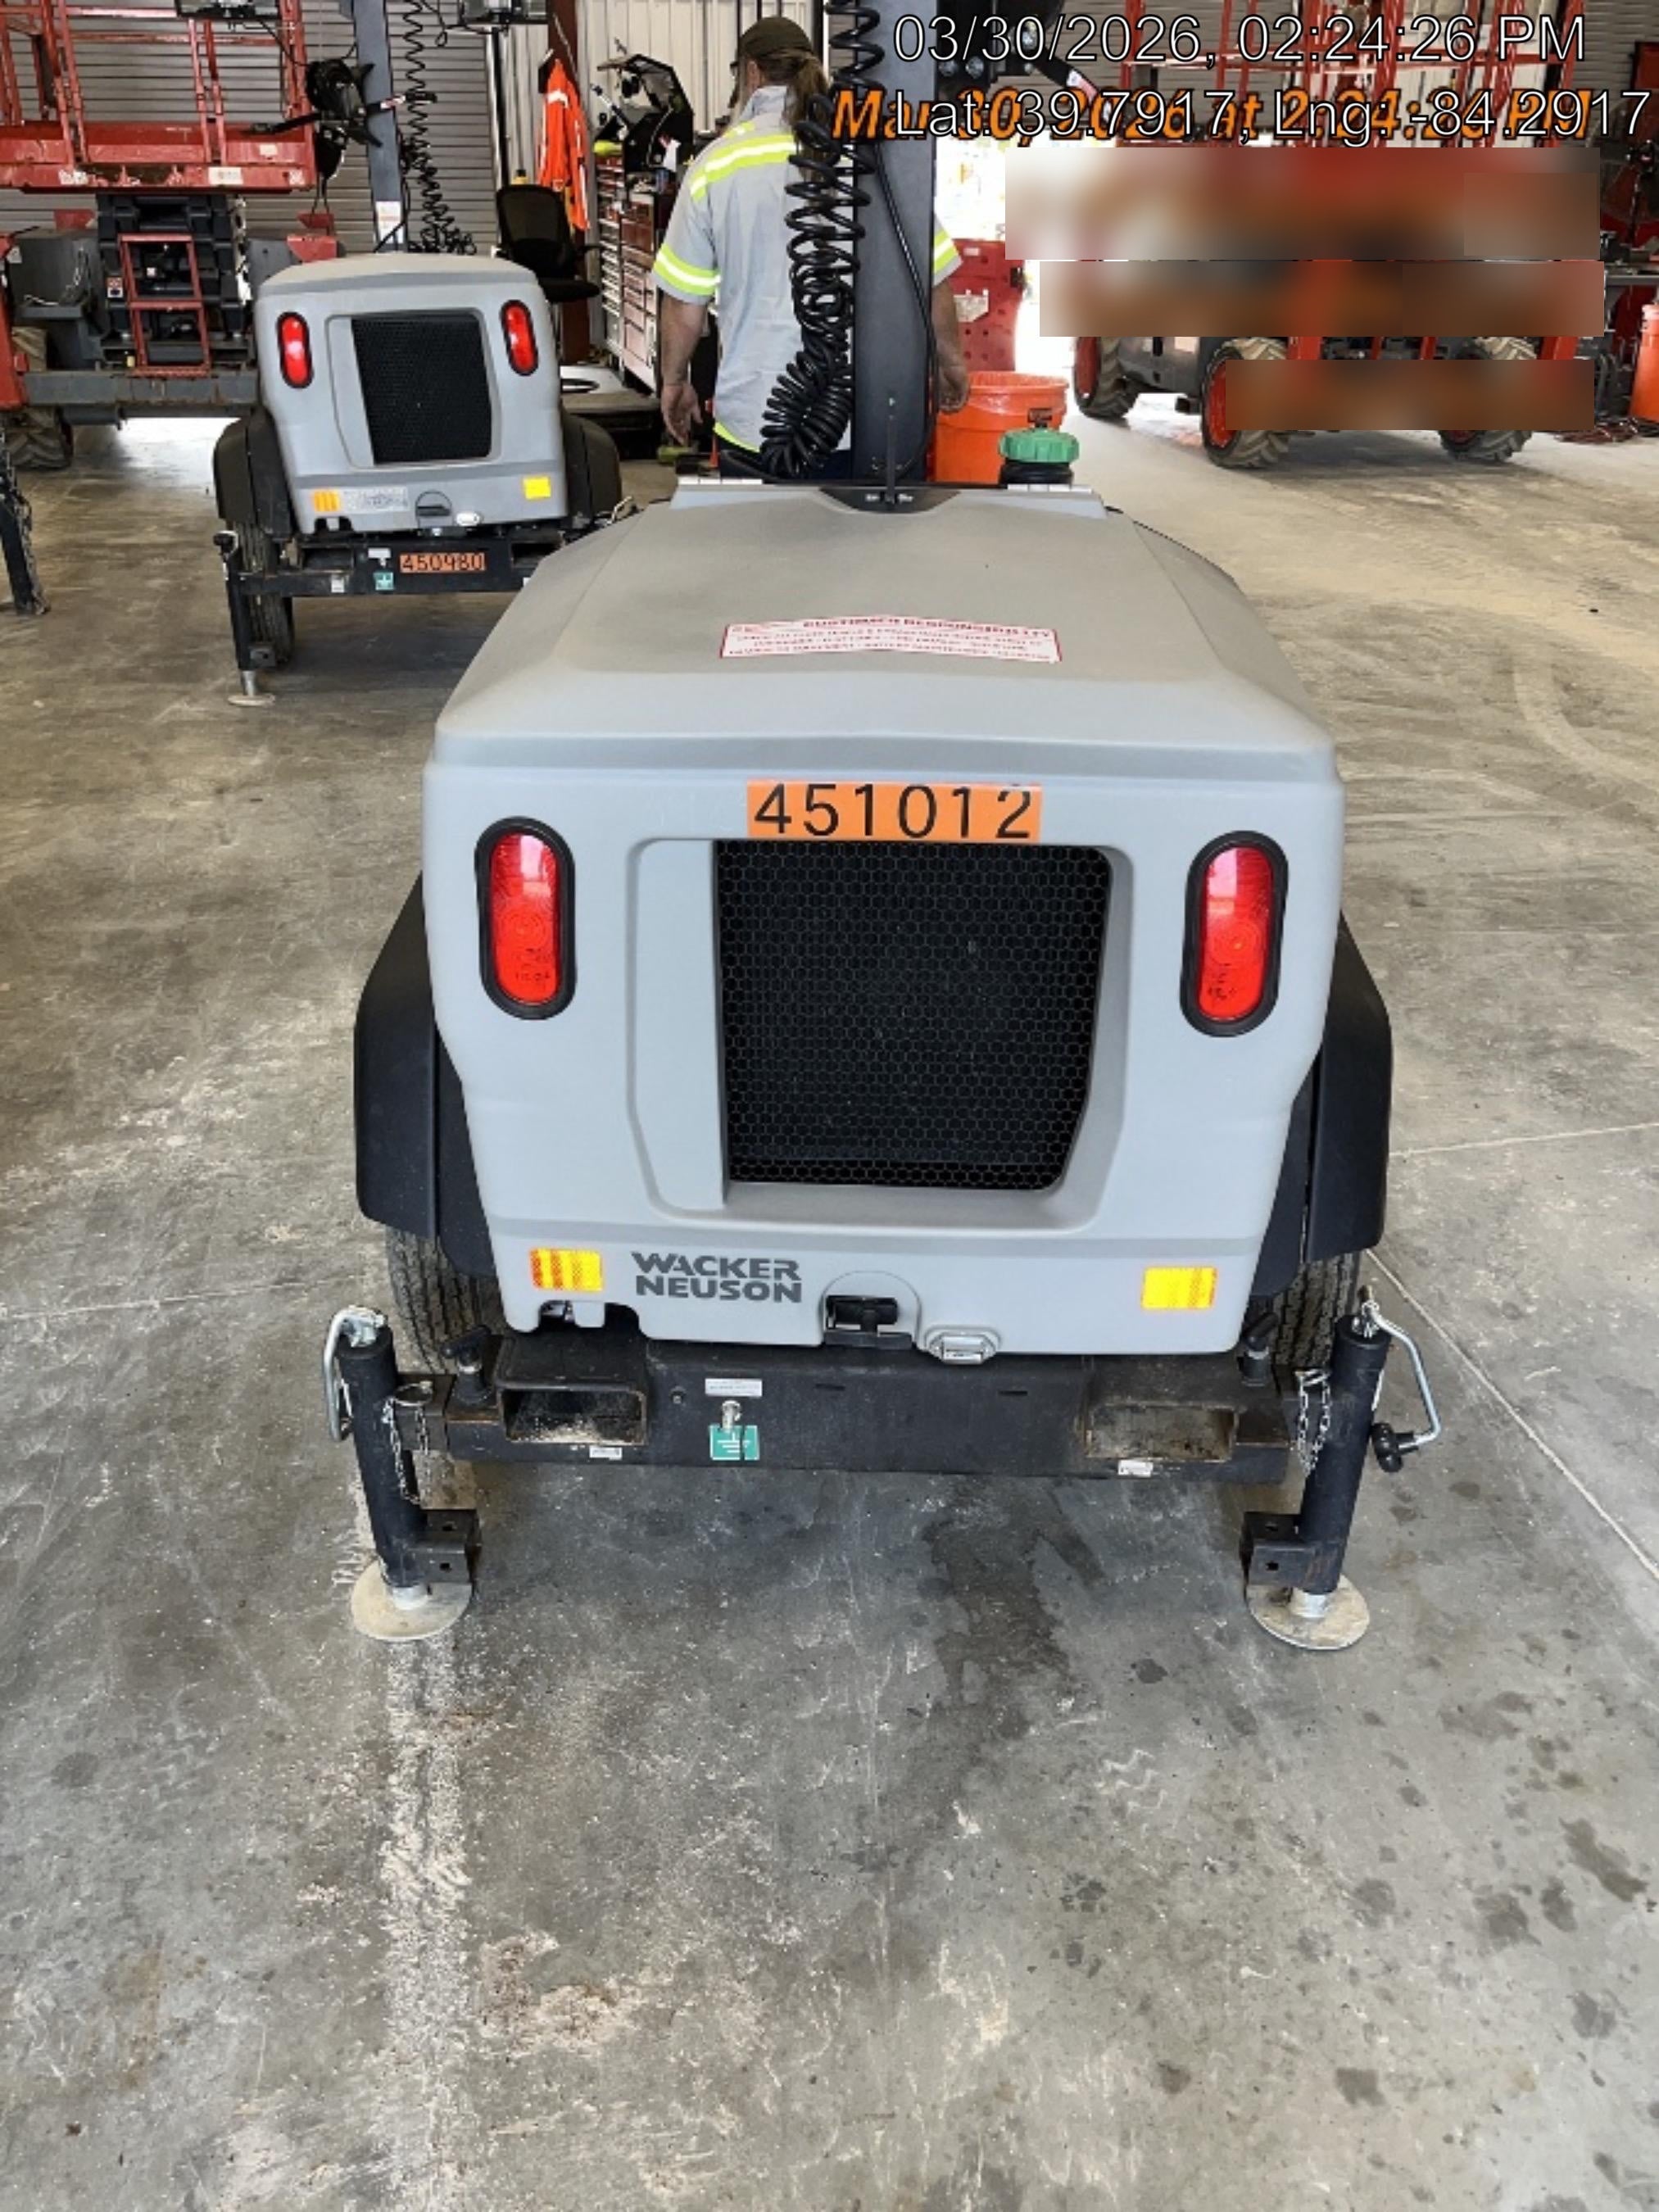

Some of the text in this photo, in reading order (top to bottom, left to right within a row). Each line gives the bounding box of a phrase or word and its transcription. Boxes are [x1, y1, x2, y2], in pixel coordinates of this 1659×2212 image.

[753, 782, 1031, 839] 451012
[630, 1250, 802, 1281] WACKER
[636, 1275, 802, 1303] NEUSON
